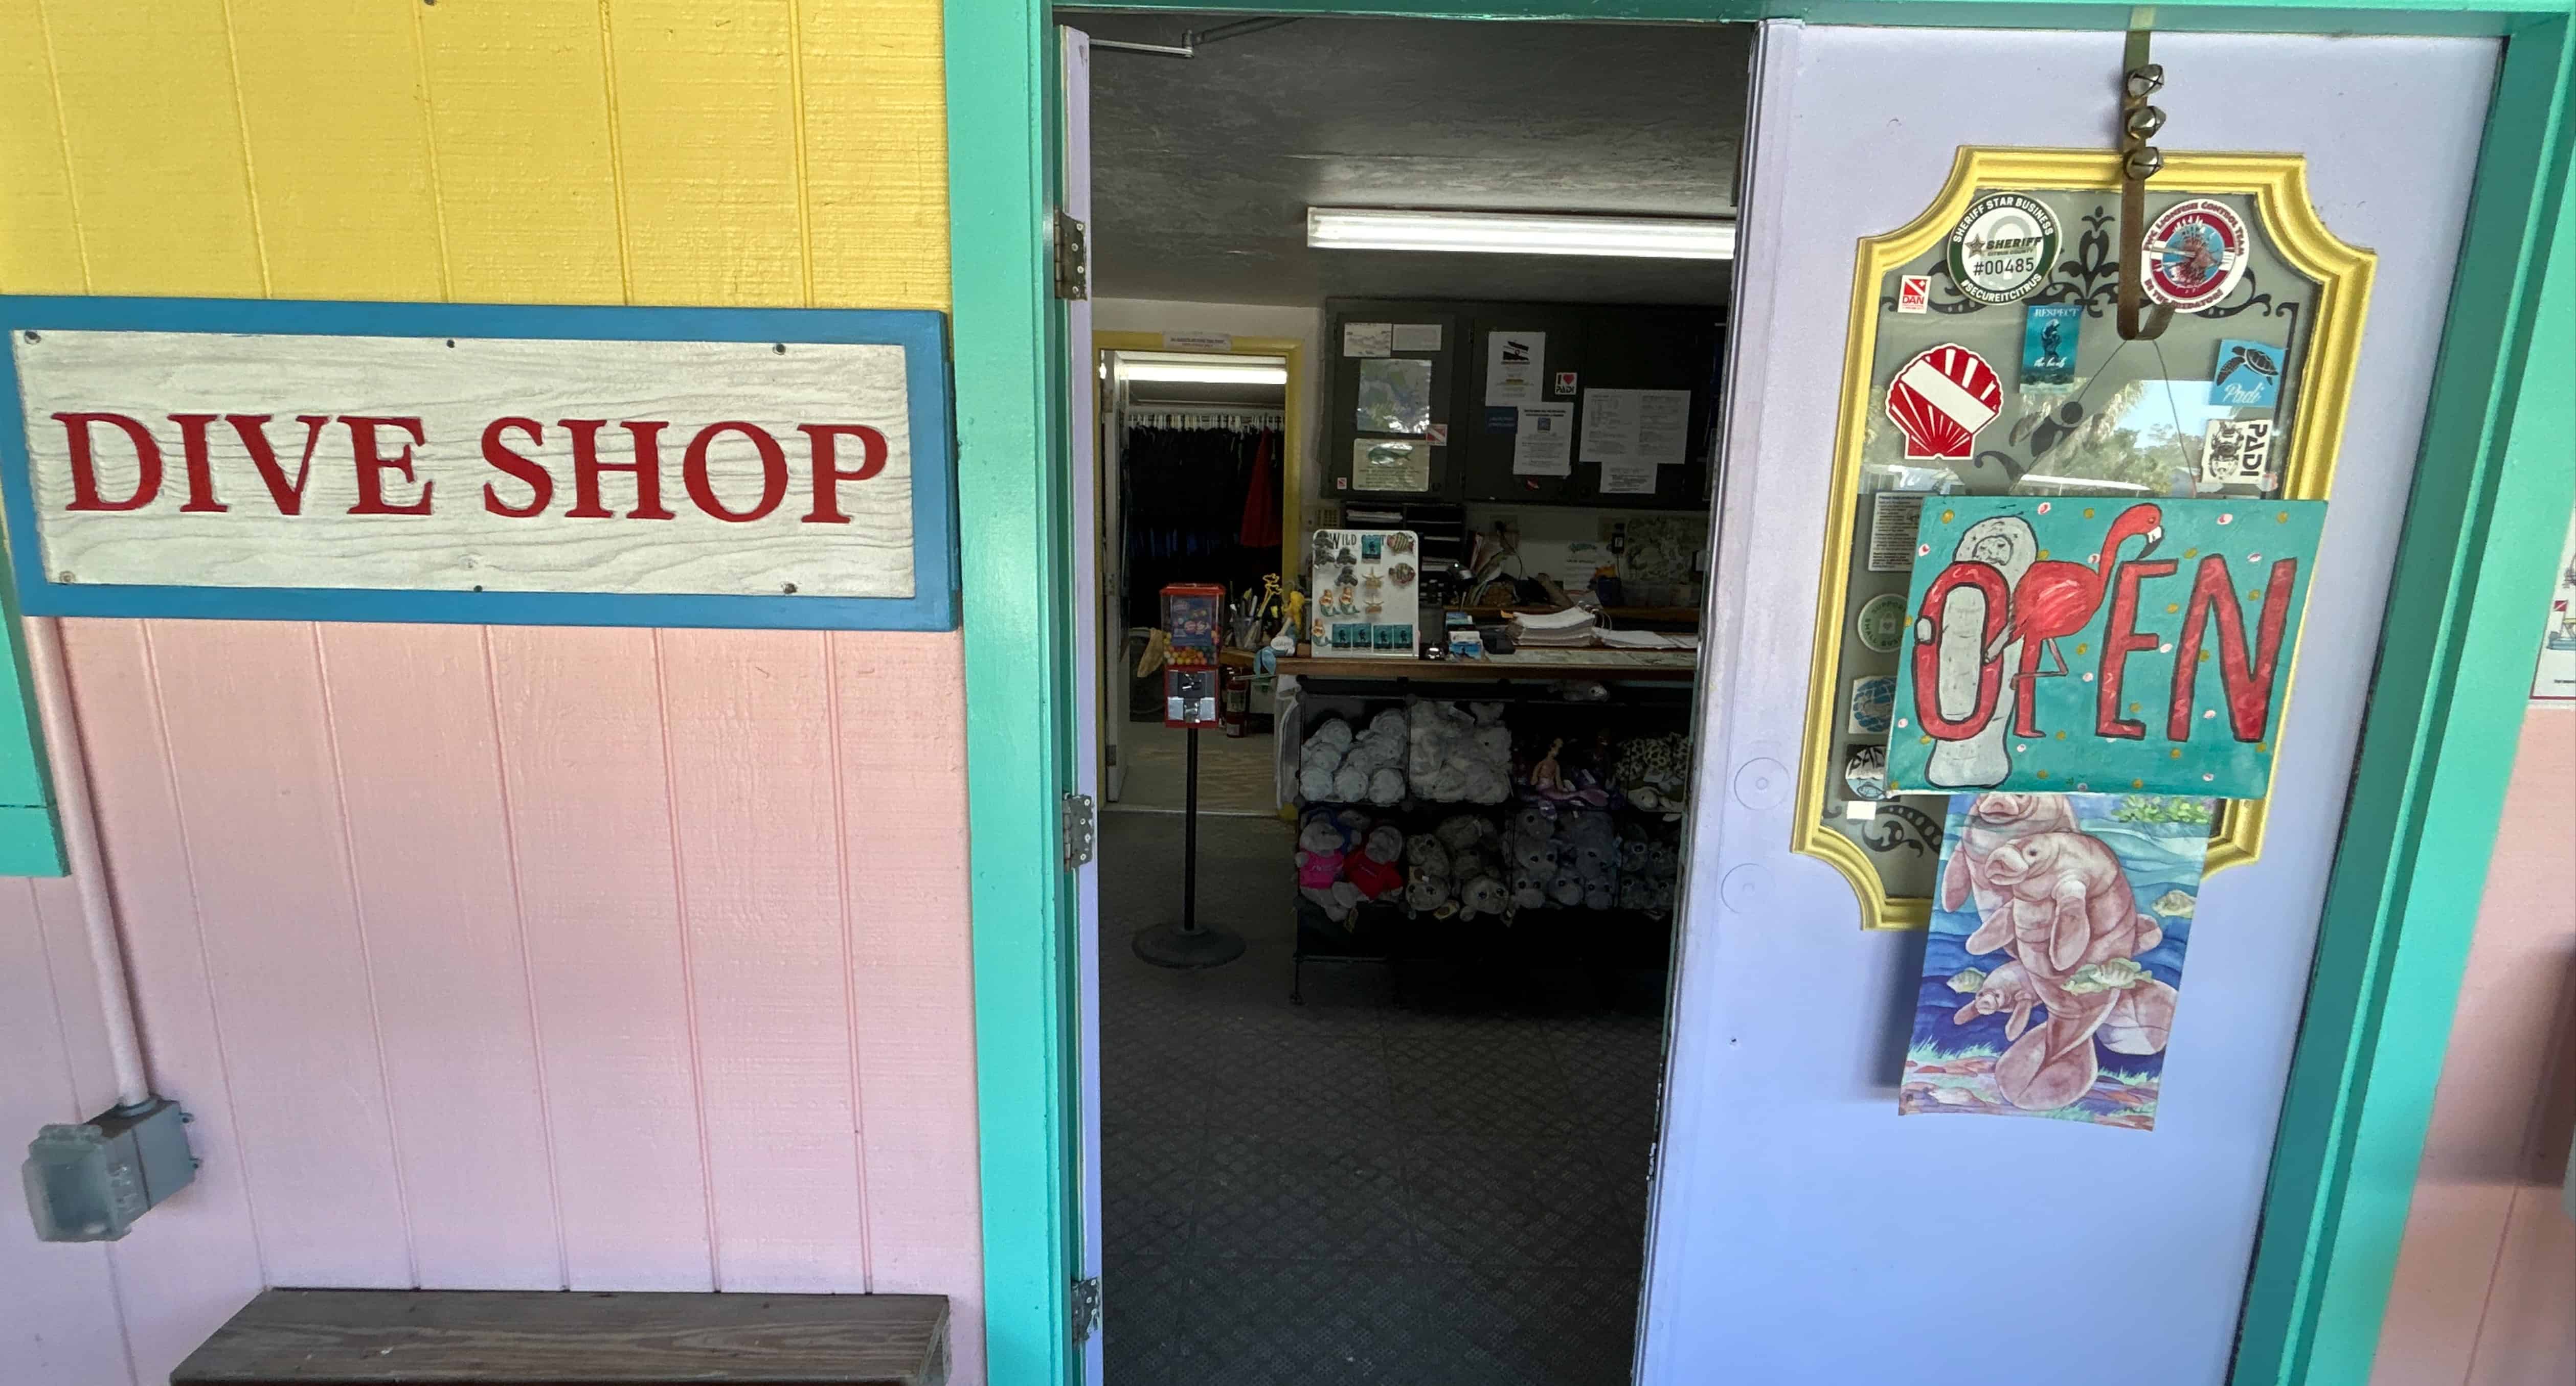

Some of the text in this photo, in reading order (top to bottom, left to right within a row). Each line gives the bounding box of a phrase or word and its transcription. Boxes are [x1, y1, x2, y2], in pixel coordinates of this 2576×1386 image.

[1953, 196, 2054, 243] SHERIFF STAR BUSINESS
[2201, 201, 2238, 228] CONTROL
[1987, 237, 2043, 249] SHERIFF
[1973, 257, 2034, 276] #00485
[1960, 272, 2042, 302] #SECUREITCITRUS
[1902, 296, 1924, 304] DAN
[2034, 308, 2078, 317] RESPECT
[2240, 424, 2268, 476] PADI
[52, 412, 889, 525] DIVE SHOP
[1329, 532, 1357, 549] WILD
[1912, 553, 2297, 742] OPEN
[1849, 746, 1886, 770] PAD
